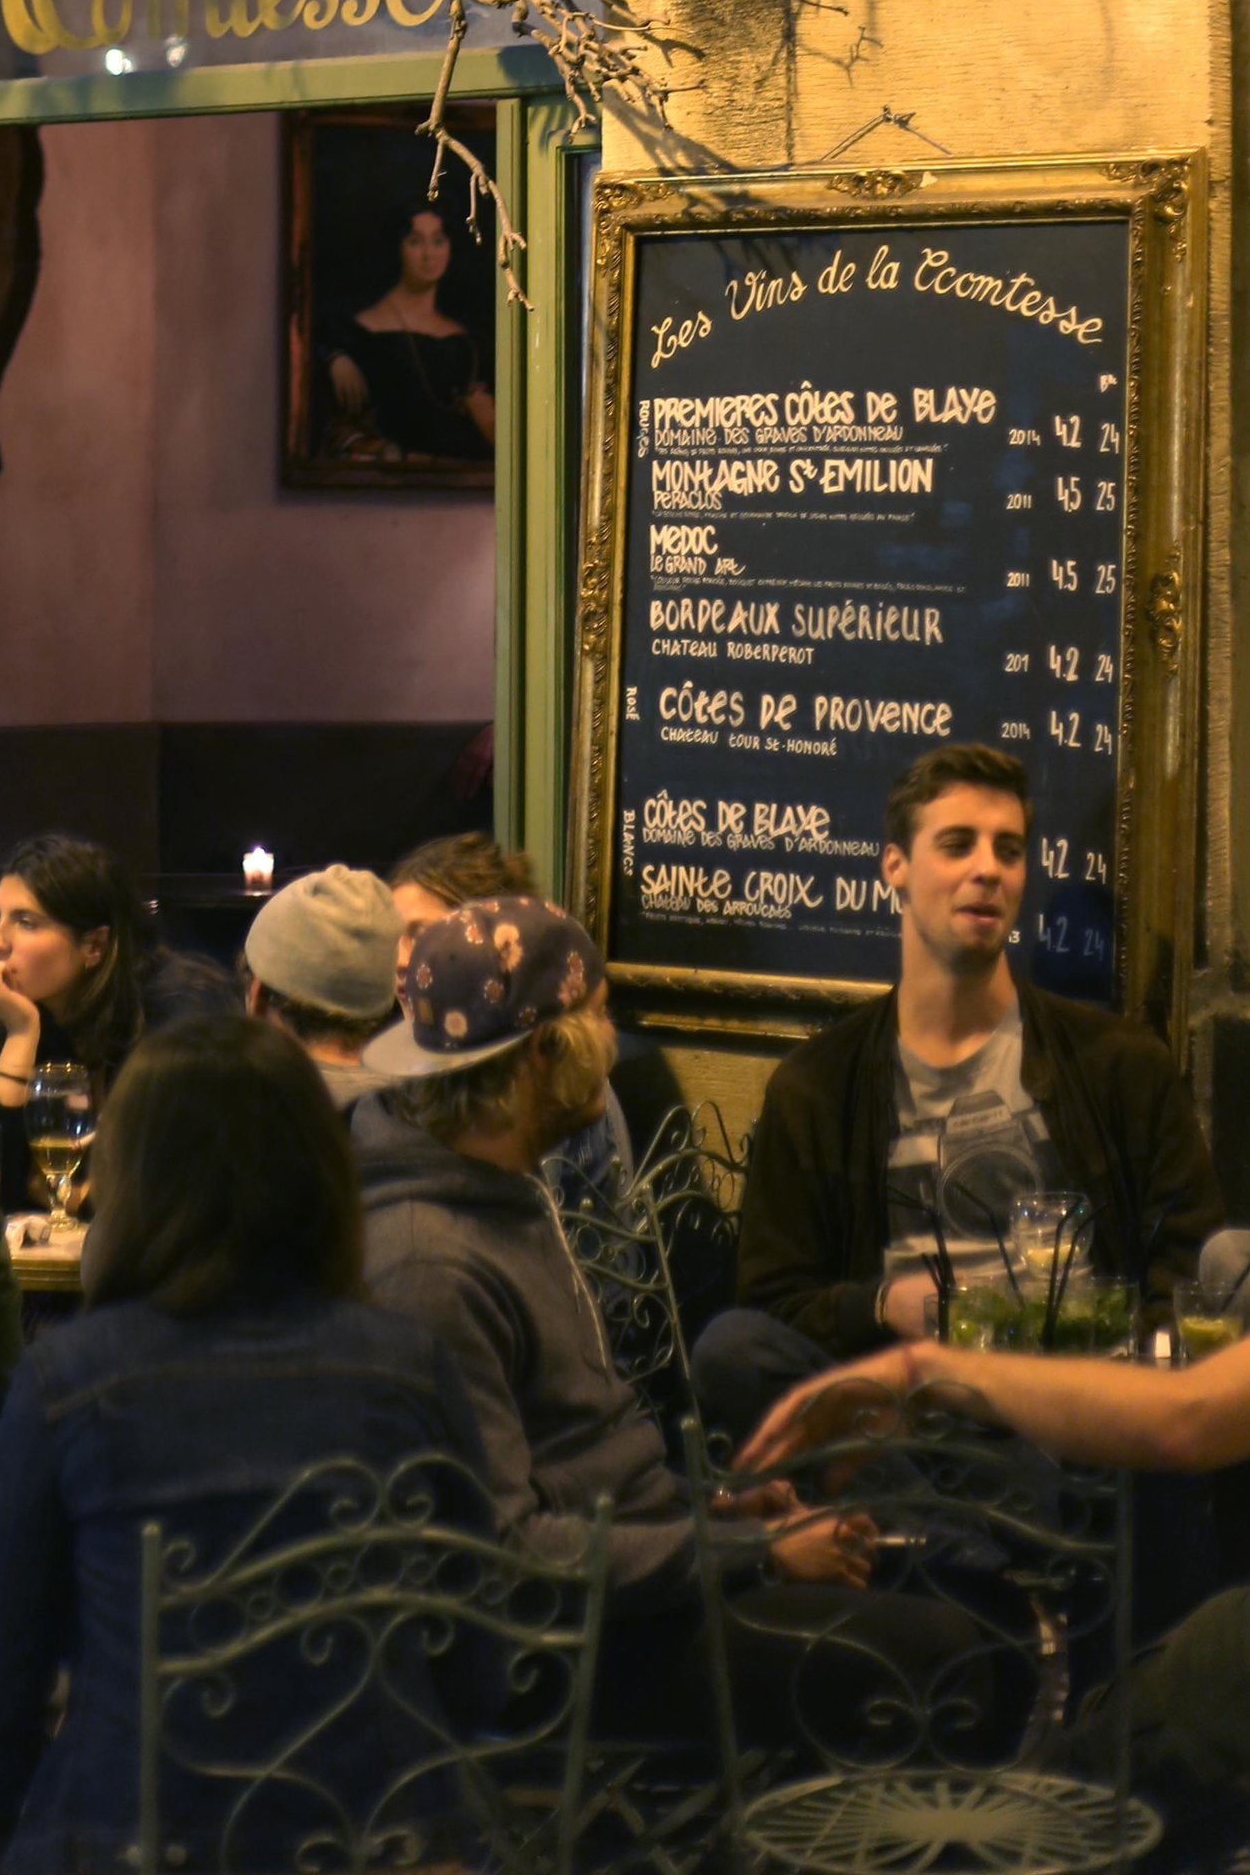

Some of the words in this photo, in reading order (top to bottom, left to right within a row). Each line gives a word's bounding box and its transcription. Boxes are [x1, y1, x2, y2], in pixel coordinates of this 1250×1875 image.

[650, 311, 713, 369] Les
[725, 269, 807, 320] Vins
[817, 250, 856, 295] de
[866, 244, 901, 291] la
[1008, 428, 1041, 446] 2014
[1100, 423, 1120, 453] 24
[1006, 493, 1032, 510] 2011
[1096, 481, 1116, 511] 25
[1006, 572, 1030, 588] 2011
[1052, 559, 1078, 592] 4.5
[1095, 564, 1116, 595] 25
[1050, 645, 1080, 681] 4.2
[1095, 654, 1113, 683] 24
[1001, 722, 1030, 740] 2014
[1050, 710, 1081, 747] 4.2
[1094, 724, 1112, 755] 24
[1085, 852, 1107, 885] 24
[744, 870, 824, 909] CROIX
[835, 877, 867, 911] DU
